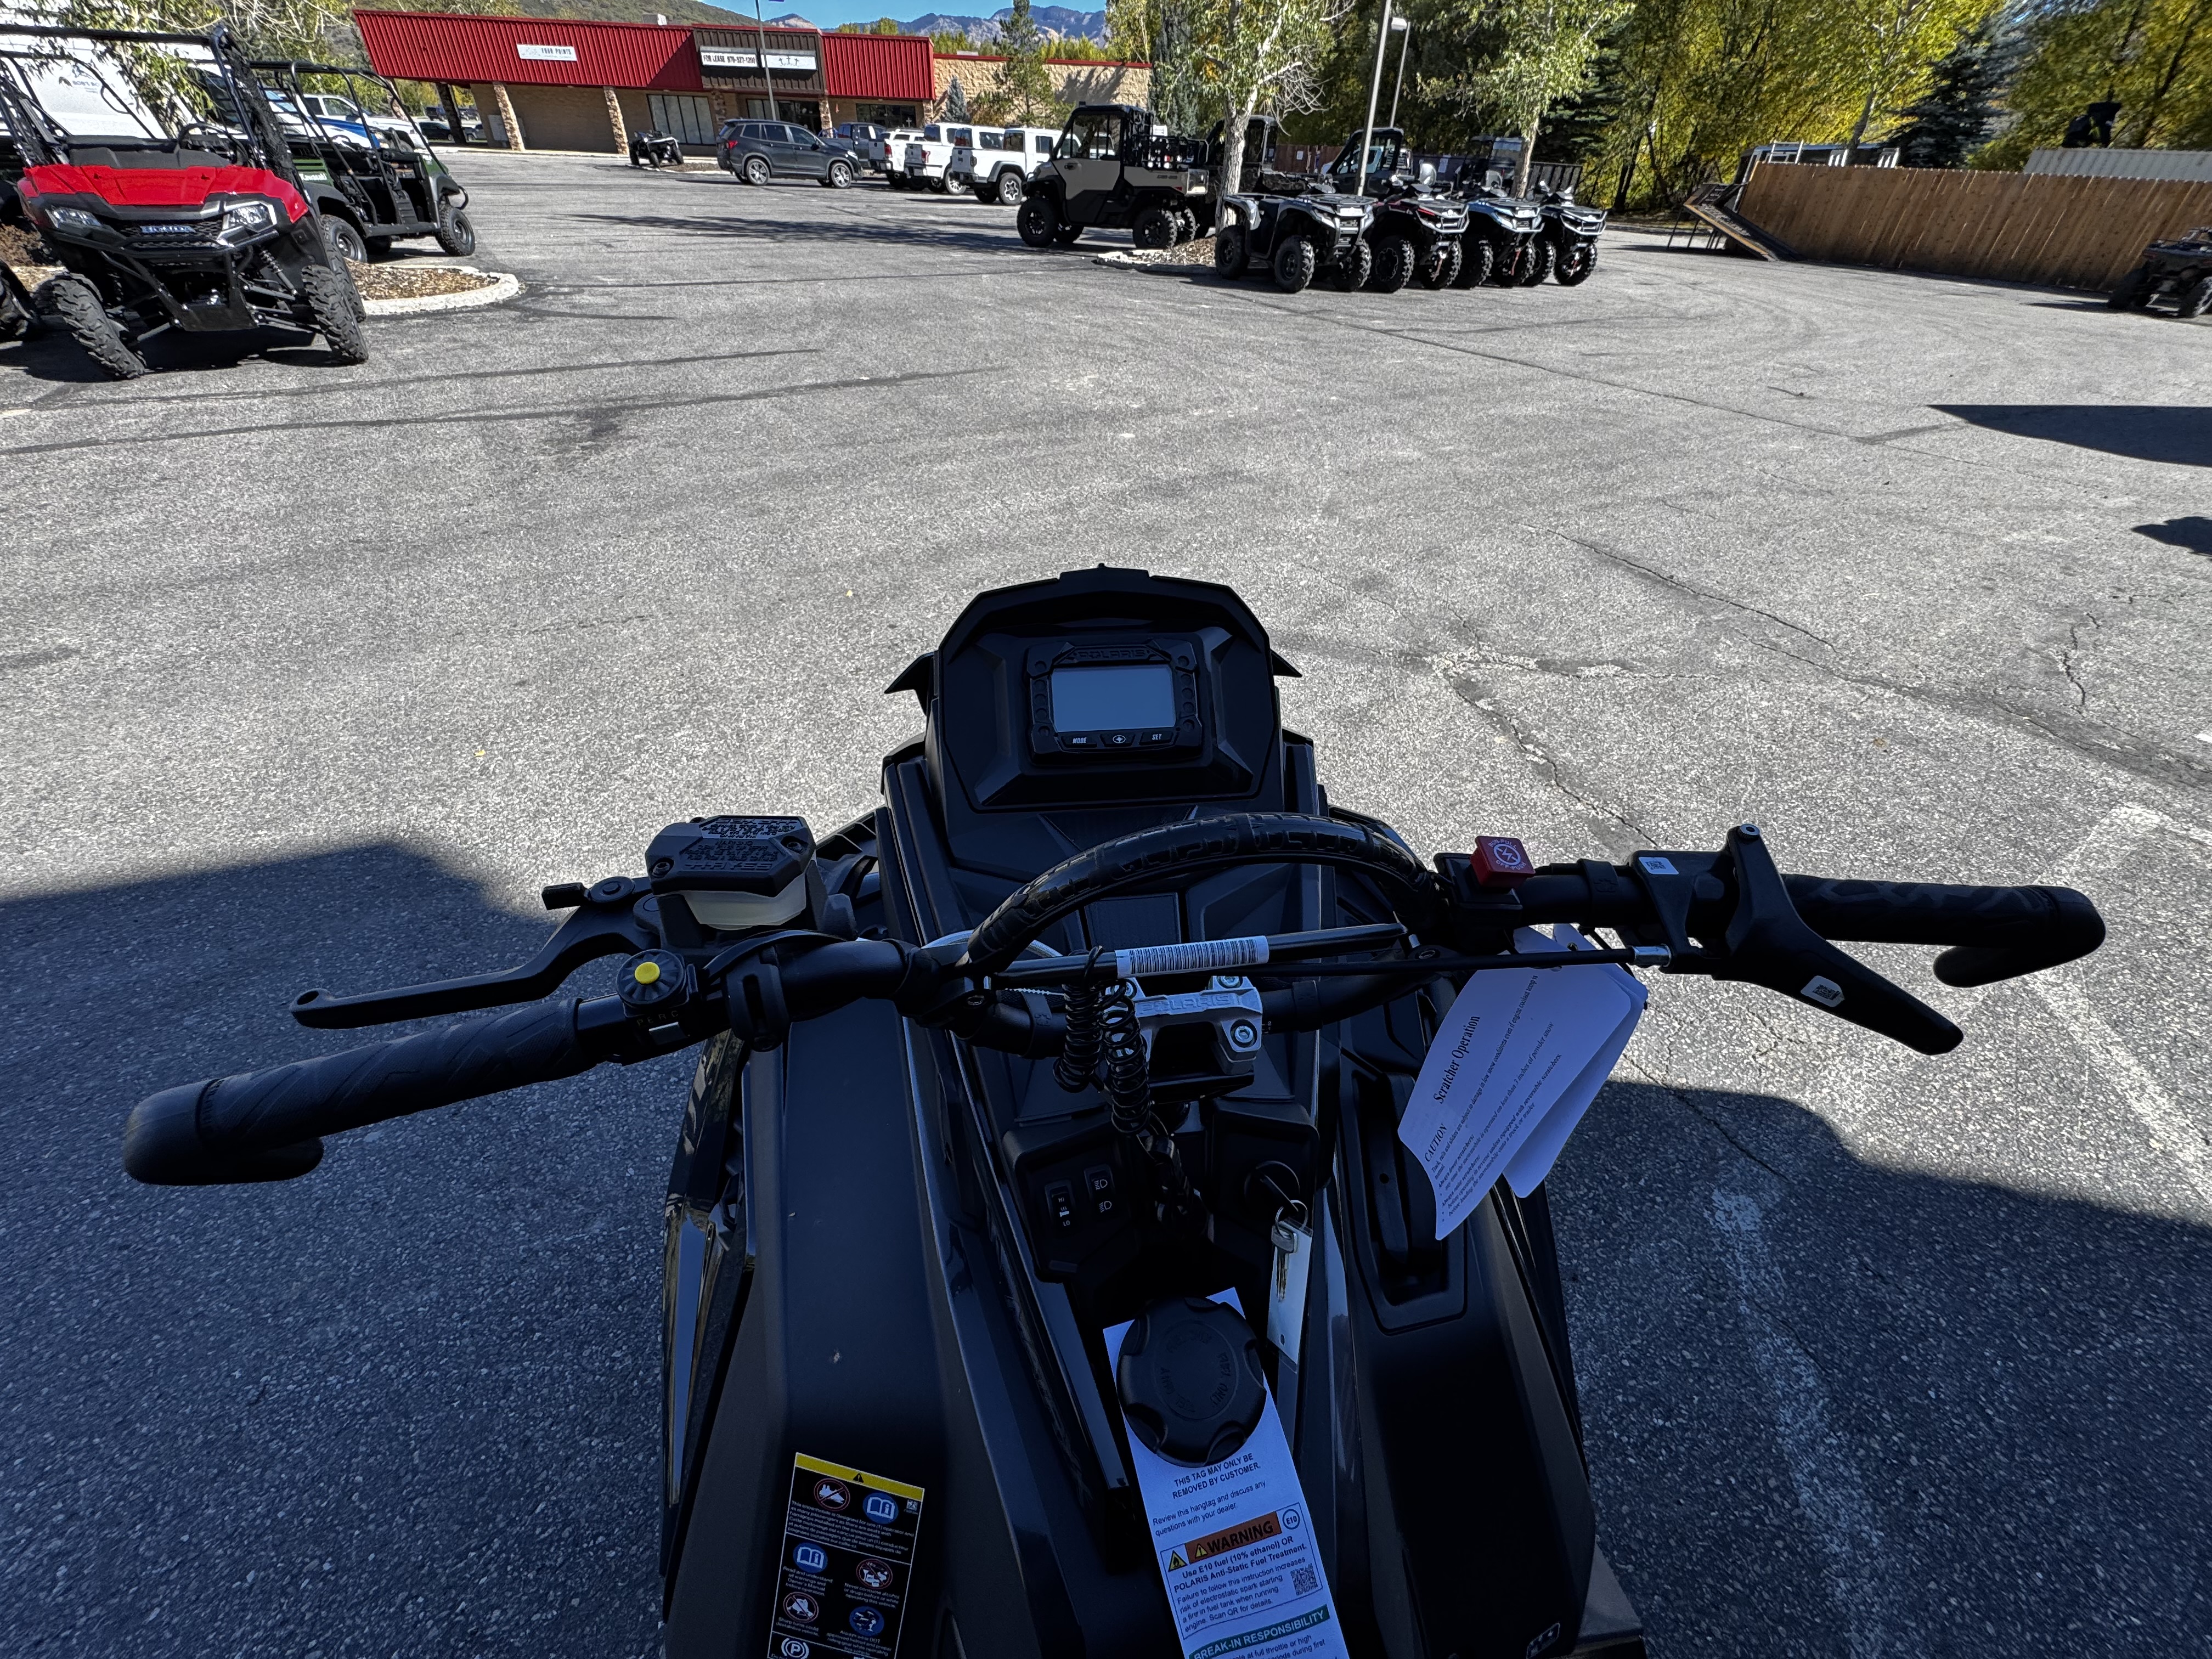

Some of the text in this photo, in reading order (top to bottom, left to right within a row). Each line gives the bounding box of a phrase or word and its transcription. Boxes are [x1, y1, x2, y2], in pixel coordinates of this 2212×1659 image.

[1077, 650, 1145, 659] POLARIS
[1139, 995, 1233, 1014] POLARIS
[1543, 1021, 1554, 1038] snow
[1433, 1016, 1480, 1104] Scratcher Operation
[1460, 1108, 1471, 1125] subject
[1470, 1087, 1482, 1105] damage
[1481, 1074, 1489, 1084] low
[1487, 1061, 1496, 1075] snow
[1493, 1038, 1508, 1062] conditions
[1504, 1027, 1513, 1039] even
[1511, 1008, 1522, 1023] engine
[1518, 991, 1530, 1008] coolant
[1525, 979, 1537, 991] temp
[1527, 1054, 1537, 1064] of
[1531, 1036, 1545, 1059] powder
[1517, 1063, 1530, 1081] inches
[1499, 1095, 1509, 1107] less
[1507, 1084, 1516, 1097] than
[1523, 1079, 1542, 1106] reversible
[1424, 1123, 1447, 1162] CAUTION
[1172, 1462, 1261, 1499] REMOVED BY CUSTOMER.
[1173, 1453, 1254, 1487] THIS TAG MAY ONLY BE
[1152, 1480, 1266, 1526] Review this hangtag and discuss any
[1155, 1520, 1186, 1537] questions
[1187, 1515, 1200, 1525] with
[1200, 1510, 1215, 1522] your
[1285, 1516, 1298, 1525] E10
[1207, 1521, 1274, 1551] WARNING
[1173, 1543, 1307, 1593] POLARIS Anti-Static Fuel Treatment.
[1182, 1536, 1294, 1578] Use E10 fuel (10% ethanol) OR
[1177, 1592, 1199, 1605] Failure
[1207, 1582, 1227, 1593] follow
[1228, 1577, 1240, 1587] this
[1241, 1567, 1274, 1583] instruction
[1274, 1556, 1306, 1572] increases
[1180, 1575, 1283, 1615] risk of electrostatic spark starting
[1187, 1611, 1199, 1621] fire
[1206, 1602, 1219, 1612] fuel
[1220, 1598, 1235, 1609] tank
[1235, 1594, 1254, 1604] when
[1254, 1586, 1279, 1599] running
[1209, 1611, 1226, 1621] Scan
[1227, 1606, 1239, 1616] QR
[1239, 1605, 1248, 1613] for
[1250, 1598, 1273, 1610] details.
[1194, 1610, 1323, 1659] BREAK-IN RESPONSIBILITY
[1254, 1648, 1265, 1657] full
[1265, 1643, 1288, 1654] throttle
[1297, 1634, 1312, 1645] high
[1292, 1638, 1325, 1656] during first
